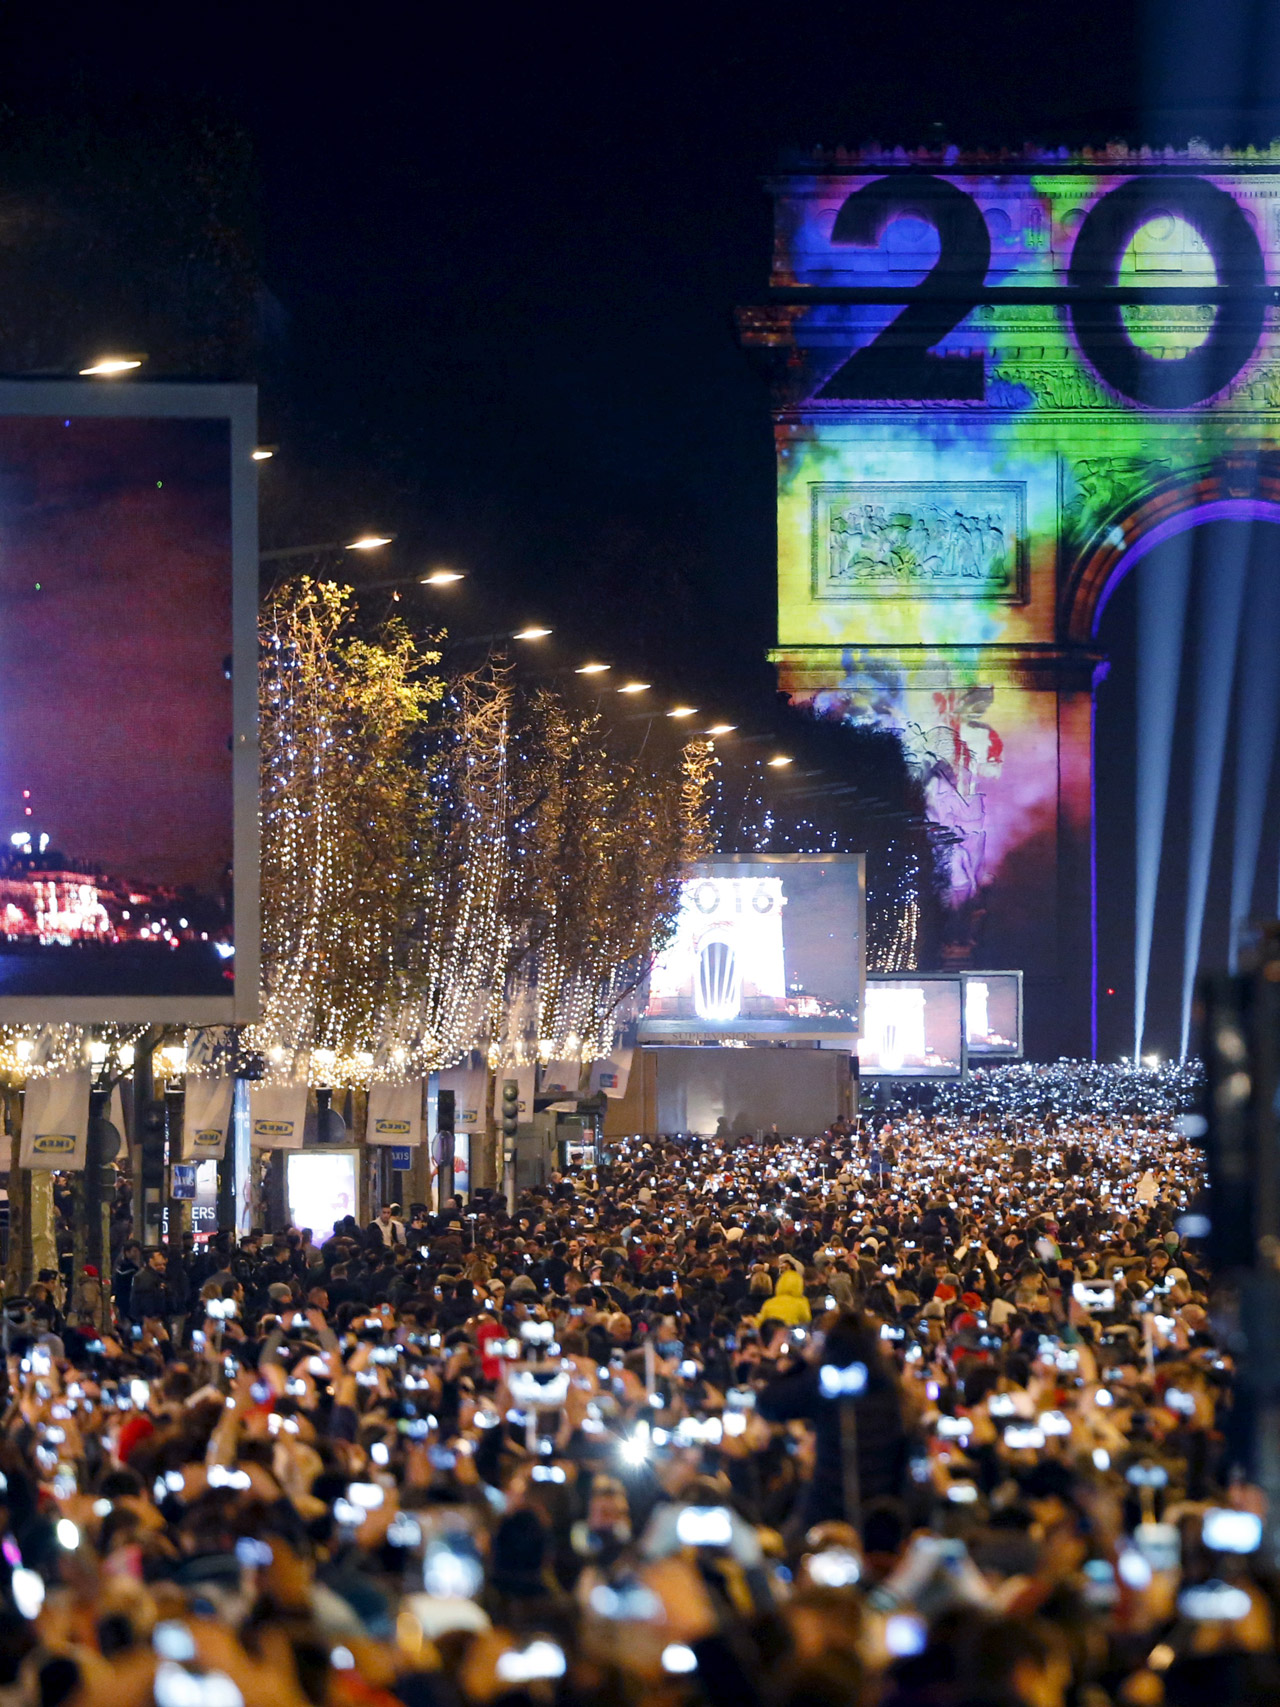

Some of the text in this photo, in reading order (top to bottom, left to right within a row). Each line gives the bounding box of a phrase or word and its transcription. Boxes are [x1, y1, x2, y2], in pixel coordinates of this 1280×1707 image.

[694, 881, 774, 914] 016
[672, 1032, 757, 1040] SUPERVISION
[392, 1152, 409, 1160] AXIS
